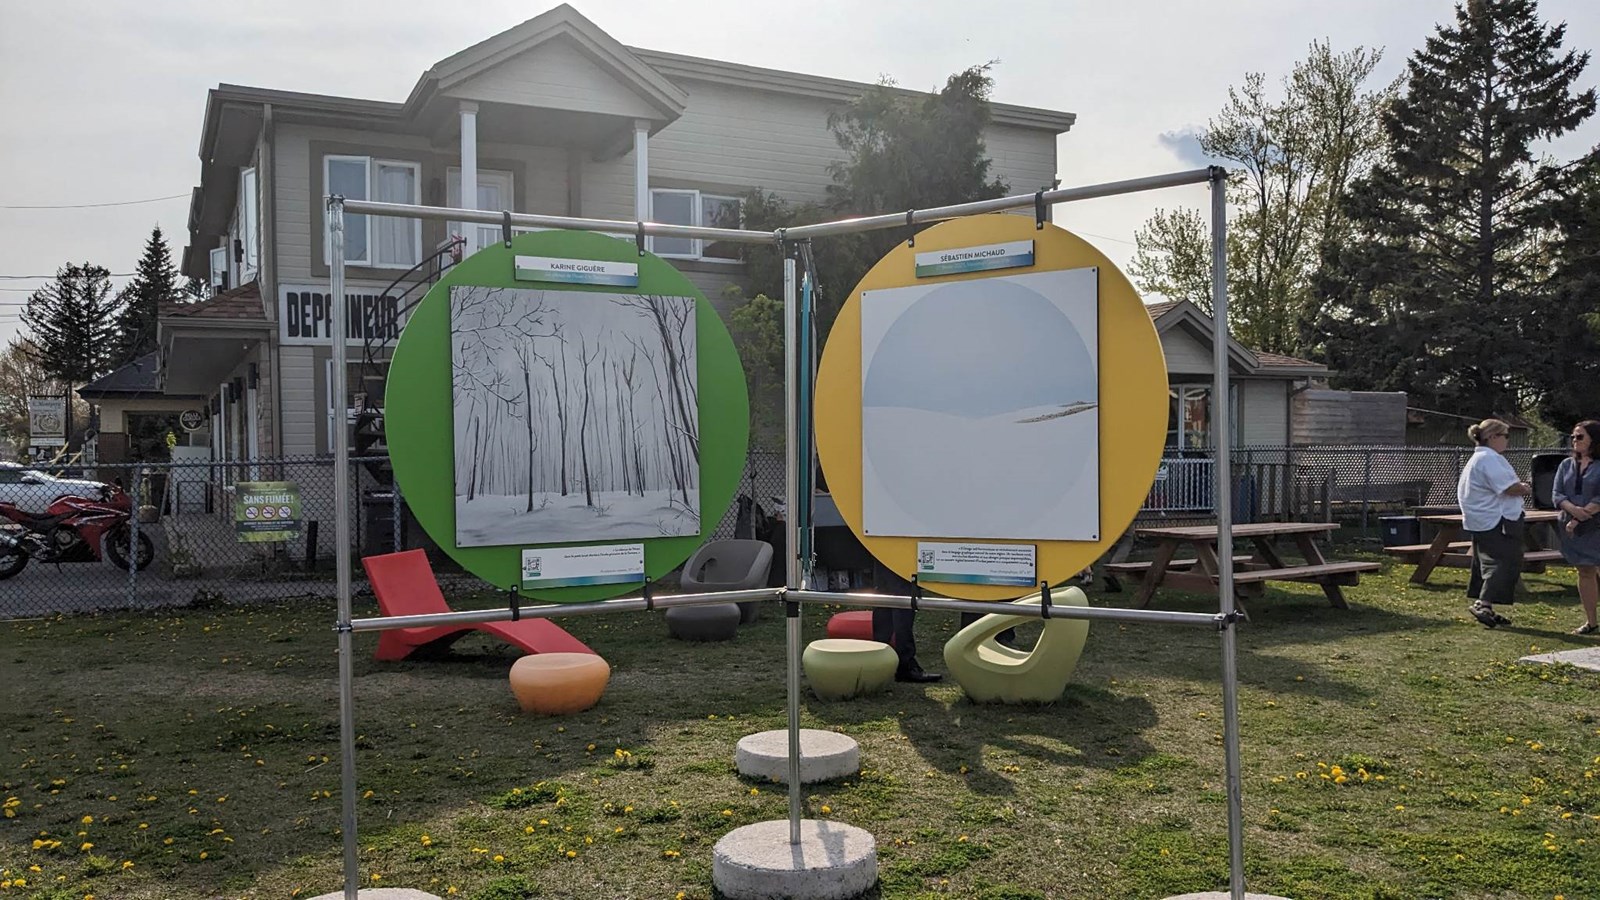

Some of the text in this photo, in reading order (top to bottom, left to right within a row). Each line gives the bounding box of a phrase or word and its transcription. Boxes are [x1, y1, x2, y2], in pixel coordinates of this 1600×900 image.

[940, 249, 1006, 262] SÉBASTIEN MICHAUD
[550, 263, 576, 271] KARINE
[243, 495, 264, 504] SANS
